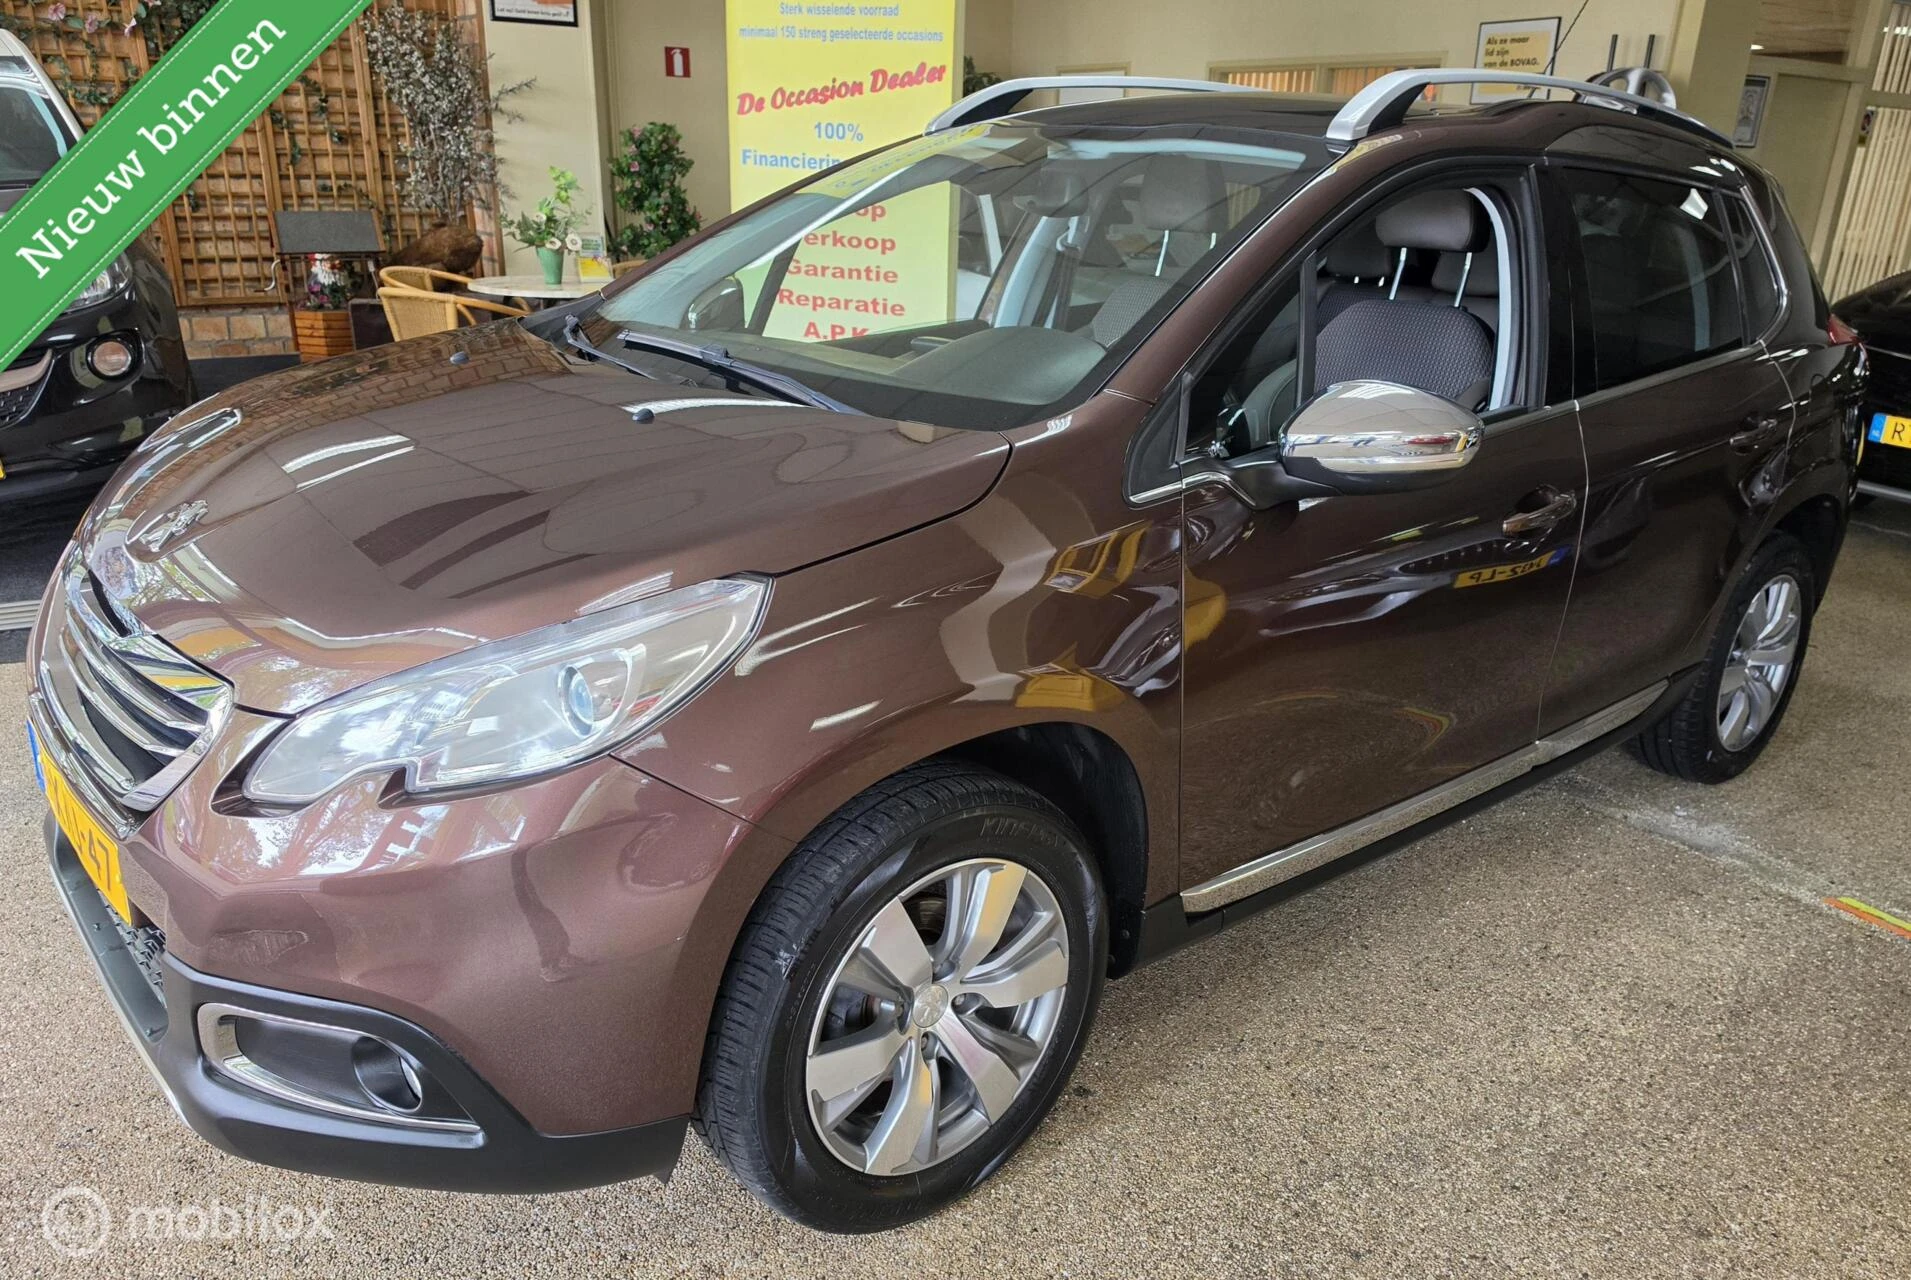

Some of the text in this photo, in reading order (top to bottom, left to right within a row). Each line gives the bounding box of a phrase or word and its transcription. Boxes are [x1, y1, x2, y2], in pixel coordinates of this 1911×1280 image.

[780, 3, 899, 17] Sterk wisselende voorraad
[739, 26, 944, 42] minimaal 150 streng geselecteerde occasions
[1486, 37, 1498, 45] Als
[1499, 60, 1508, 68] de
[1510, 57, 1540, 67] BOVAG.
[737, 61, 947, 116] De Occasion Dealer
[814, 121, 864, 142] 100%
[741, 149, 841, 170] Financierin
[855, 204, 886, 222] op
[803, 230, 896, 255] erkoop
[787, 258, 898, 283] Garantie
[778, 288, 905, 316] Reparatie
